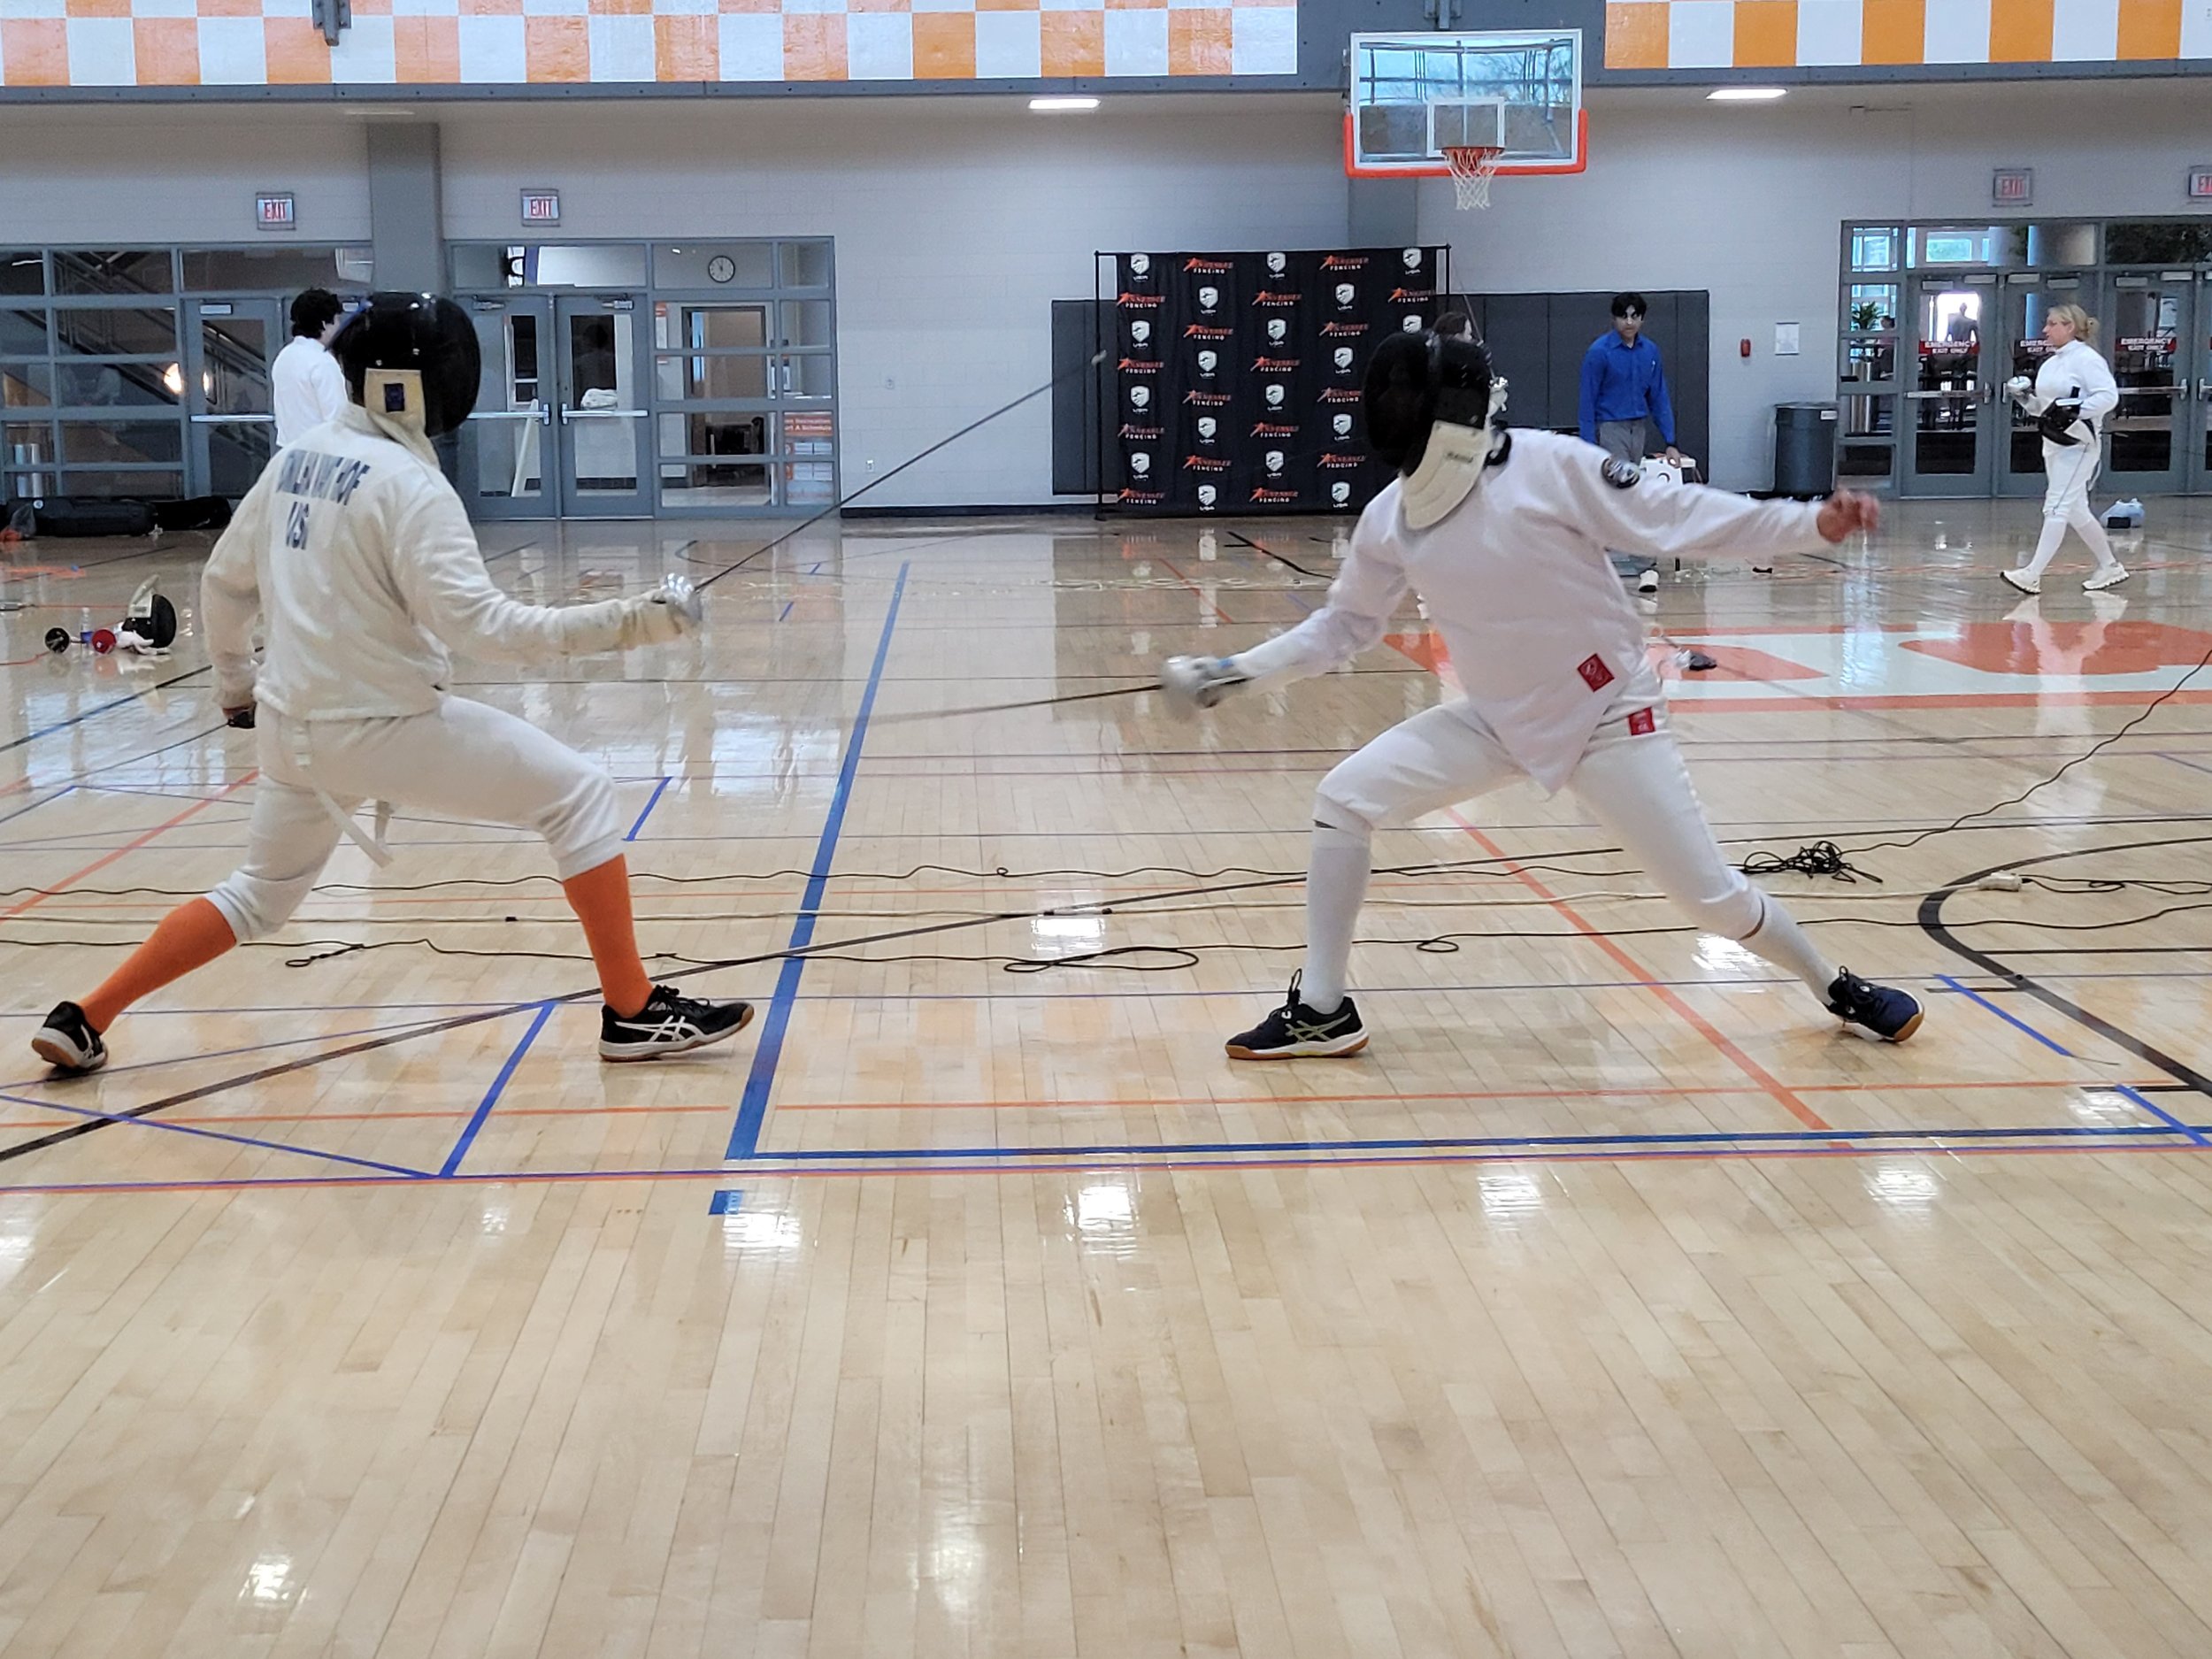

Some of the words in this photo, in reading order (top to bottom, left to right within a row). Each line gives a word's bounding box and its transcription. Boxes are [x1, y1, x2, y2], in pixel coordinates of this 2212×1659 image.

[2001, 178, 2025, 196] EXIT
[264, 201, 287, 219] EXIT
[530, 198, 552, 217] EXIT
